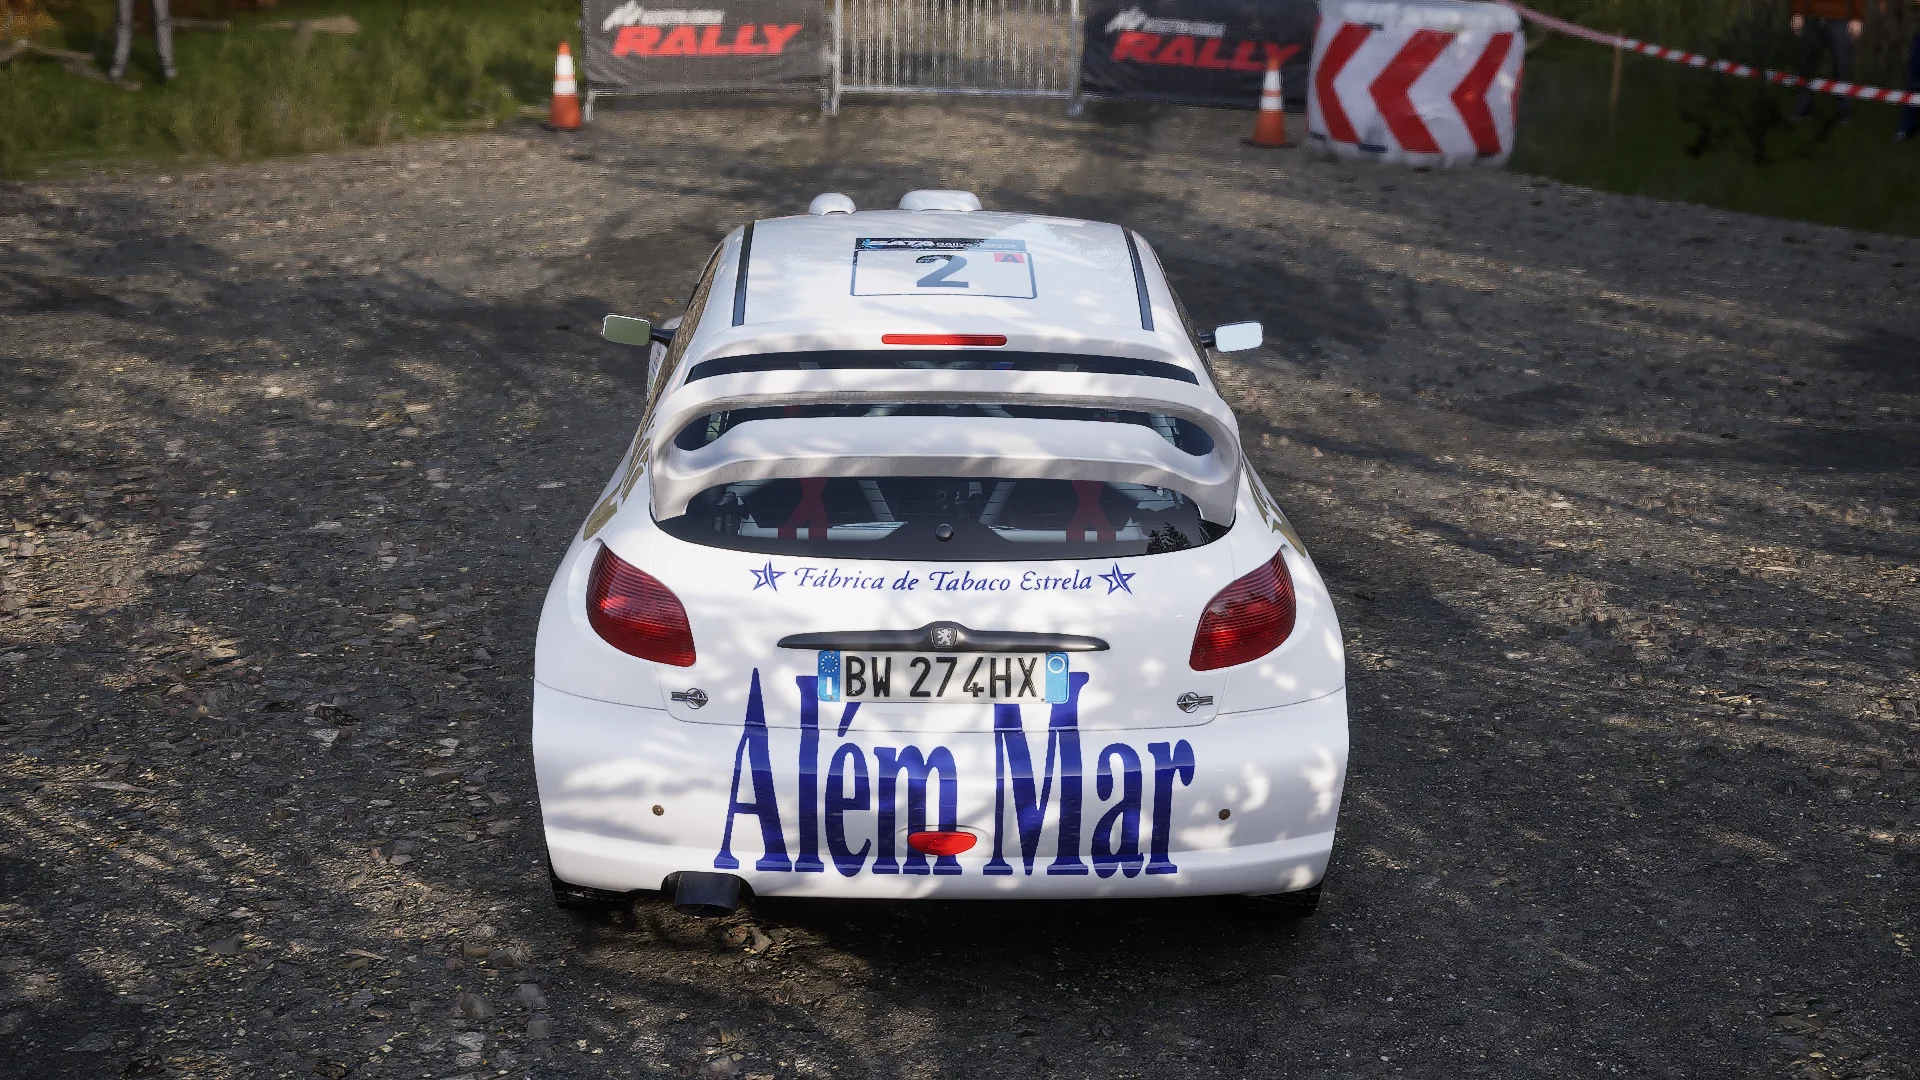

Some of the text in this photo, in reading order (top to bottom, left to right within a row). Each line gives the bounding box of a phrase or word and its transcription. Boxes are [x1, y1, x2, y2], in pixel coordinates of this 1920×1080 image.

[612, 24, 803, 56] RALLY
[1111, 31, 1304, 71] RALLY
[915, 254, 969, 288] 2
[1000, 253, 1020, 263] A
[795, 566, 1092, 591] Fábrica de Tabaco Estrela
[845, 656, 1038, 698] BW 274HX
[713, 667, 1196, 879] Além Mar
